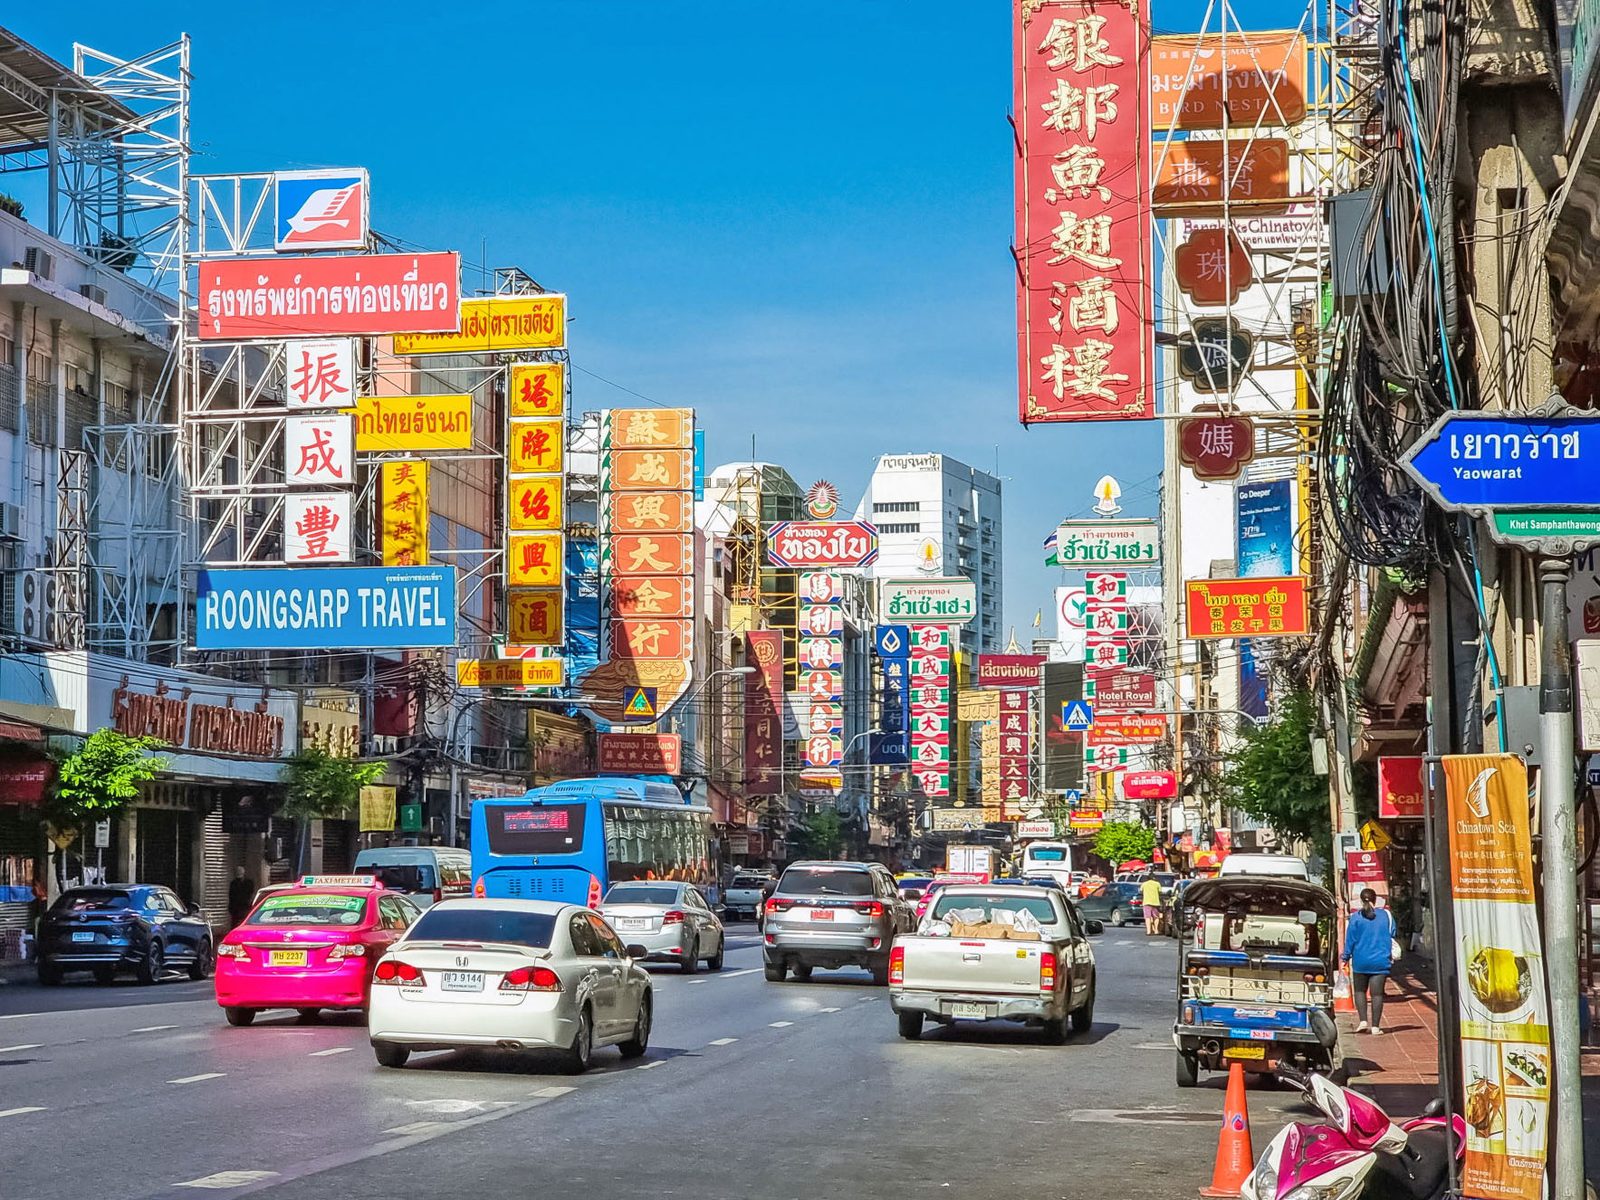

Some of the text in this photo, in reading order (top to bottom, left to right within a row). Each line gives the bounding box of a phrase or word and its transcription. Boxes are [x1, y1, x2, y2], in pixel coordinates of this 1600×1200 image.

[1037, 14, 1130, 405] 銀都魚翅酒樓
[207, 259, 449, 333] รุ่งทรัพย์การท่องเที่ยว
[289, 350, 350, 560] 振成豐
[1450, 431, 1580, 459] เยาวราช
[1453, 467, 1522, 480] Yaowarat
[1239, 489, 1271, 500] Go Deeper
[1510, 519, 1600, 533] Khet Samphanthawong
[781, 528, 868, 560] ทองใบ
[205, 586, 447, 630] ROONGSARP TRAVEL
[1098, 691, 1153, 702] Hotel Royal
[920, 629, 942, 791] 和成興大金行
[881, 745, 906, 754] UOB
[286, 952, 304, 960] 2237
[460, 972, 482, 983] 9144
